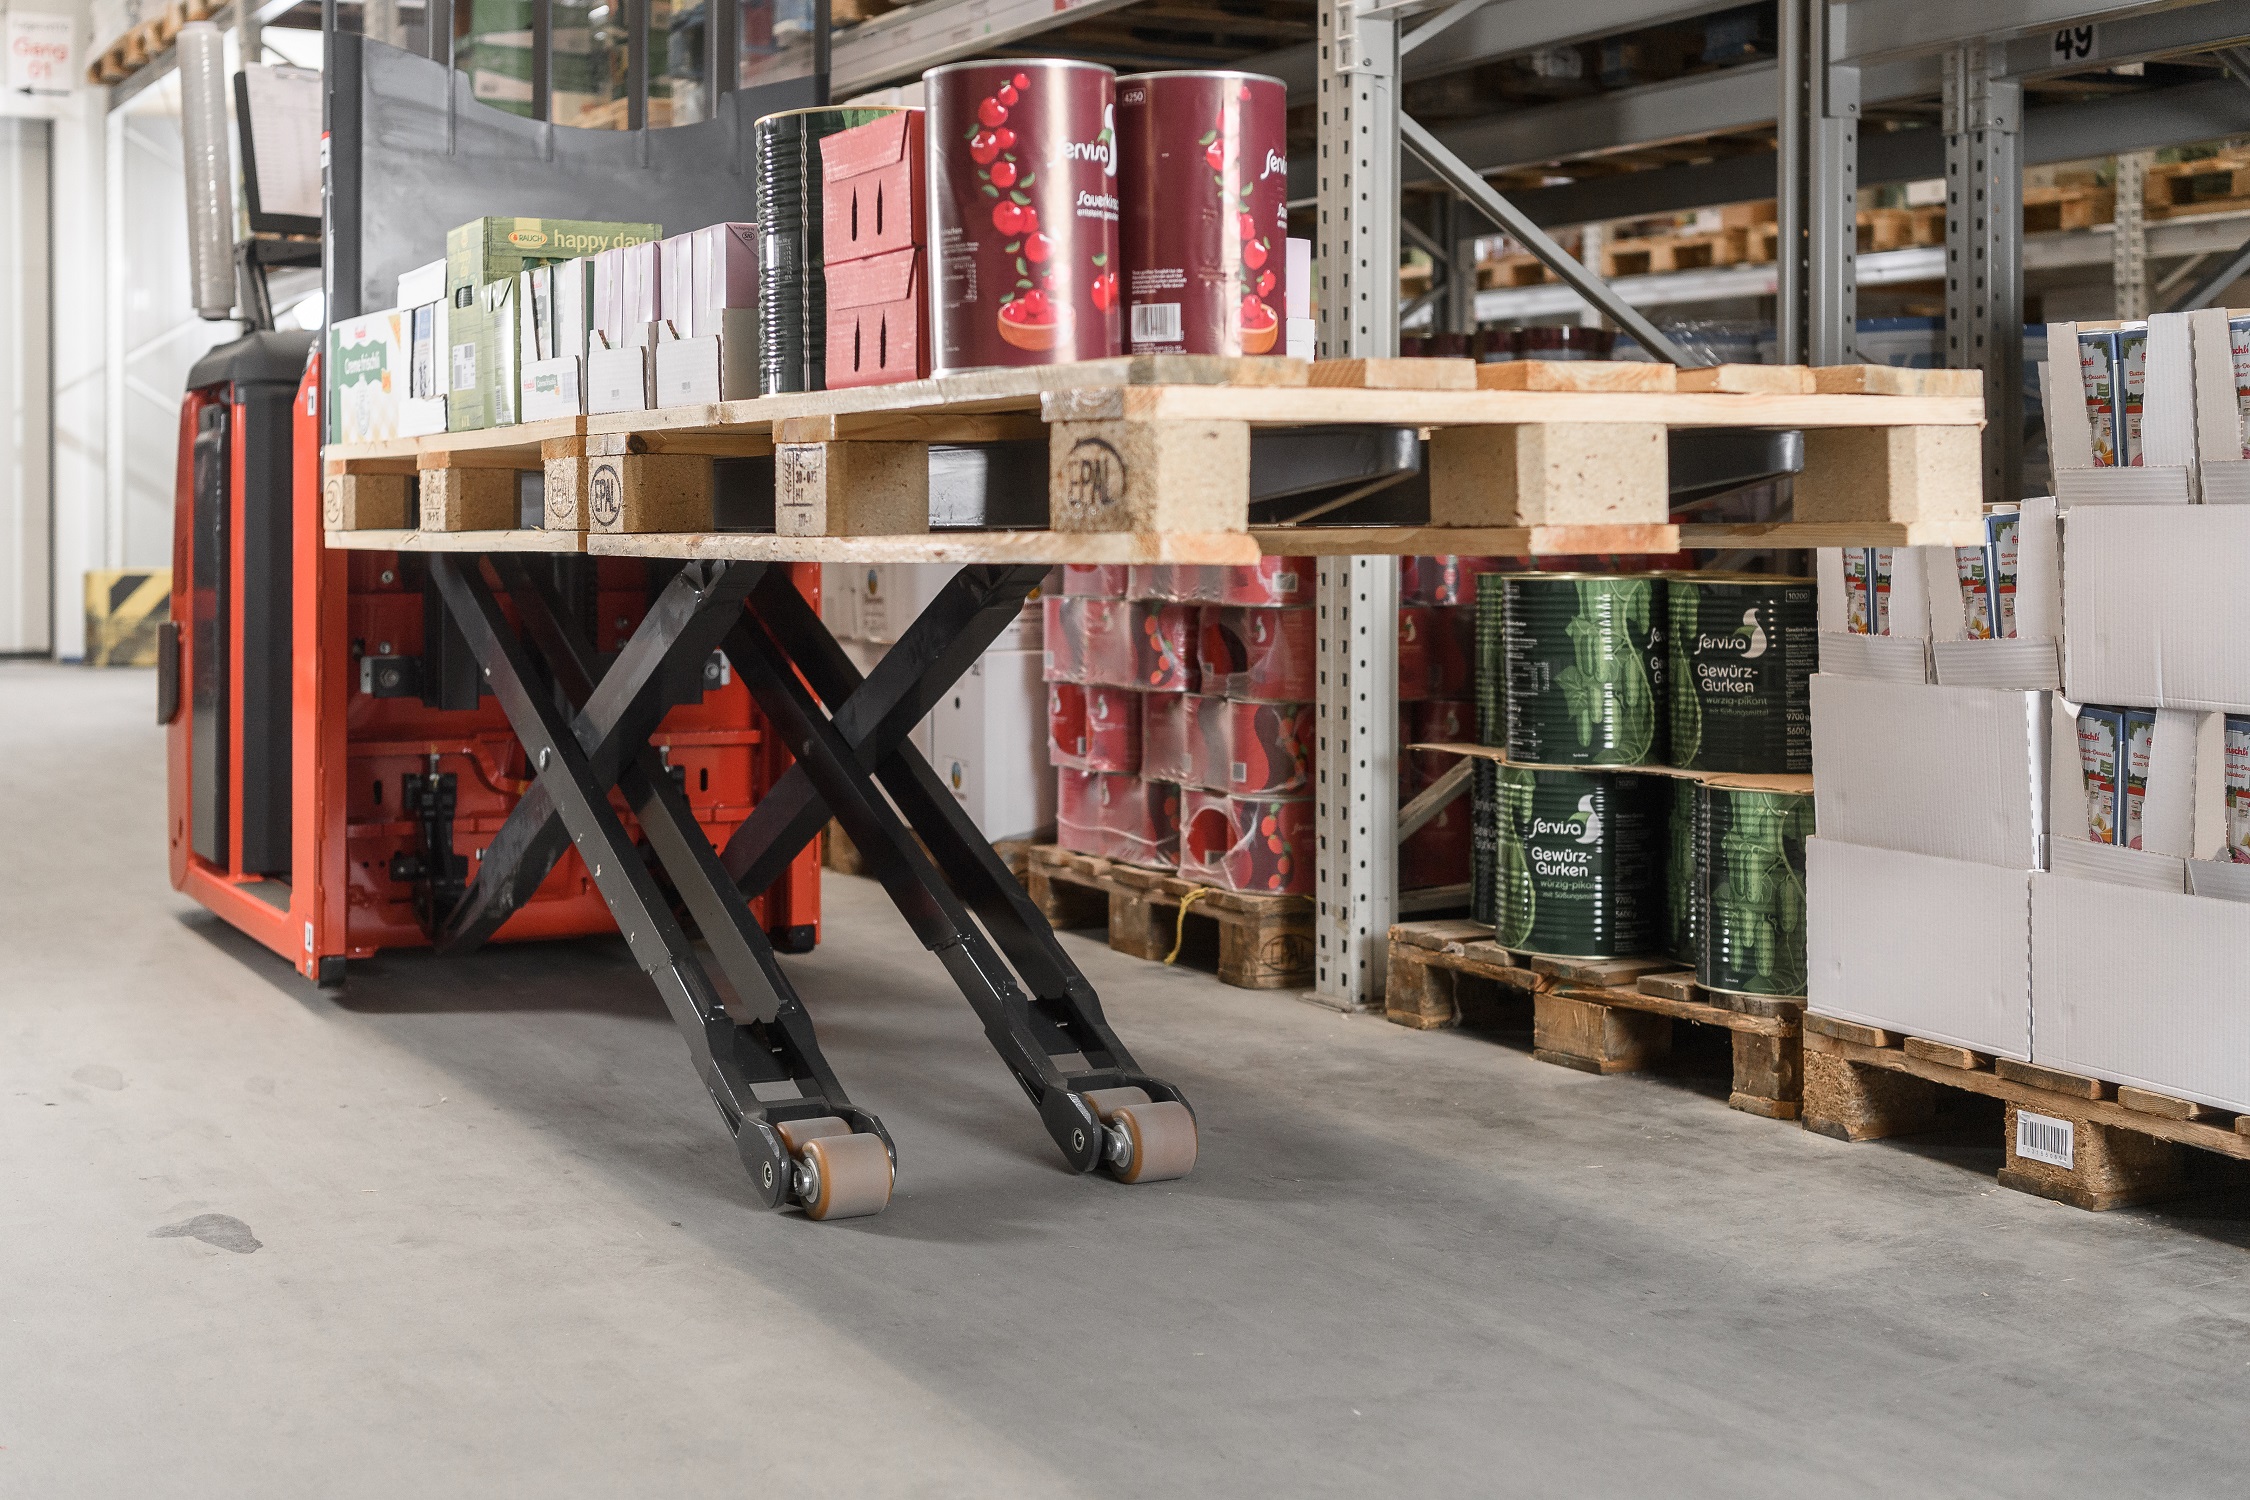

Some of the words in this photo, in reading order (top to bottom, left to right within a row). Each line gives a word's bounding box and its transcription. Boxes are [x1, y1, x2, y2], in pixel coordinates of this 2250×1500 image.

[2055, 25, 2093, 60] 49
[518, 234, 543, 243] RAUCH
[553, 229, 609, 253] happy
[1066, 458, 1115, 507] EPAL
[594, 479, 617, 513] EPAL
[1693, 632, 1747, 656] Servisa
[1697, 663, 1759, 678] Gewürz-
[1701, 679, 1754, 693] Gurken
[1786, 712, 1805, 721] 9700
[1786, 727, 1806, 736] 5600
[1528, 817, 1582, 839] Servisa
[1531, 846, 1593, 863] Gewürz-
[1535, 861, 1589, 877] Gurken
